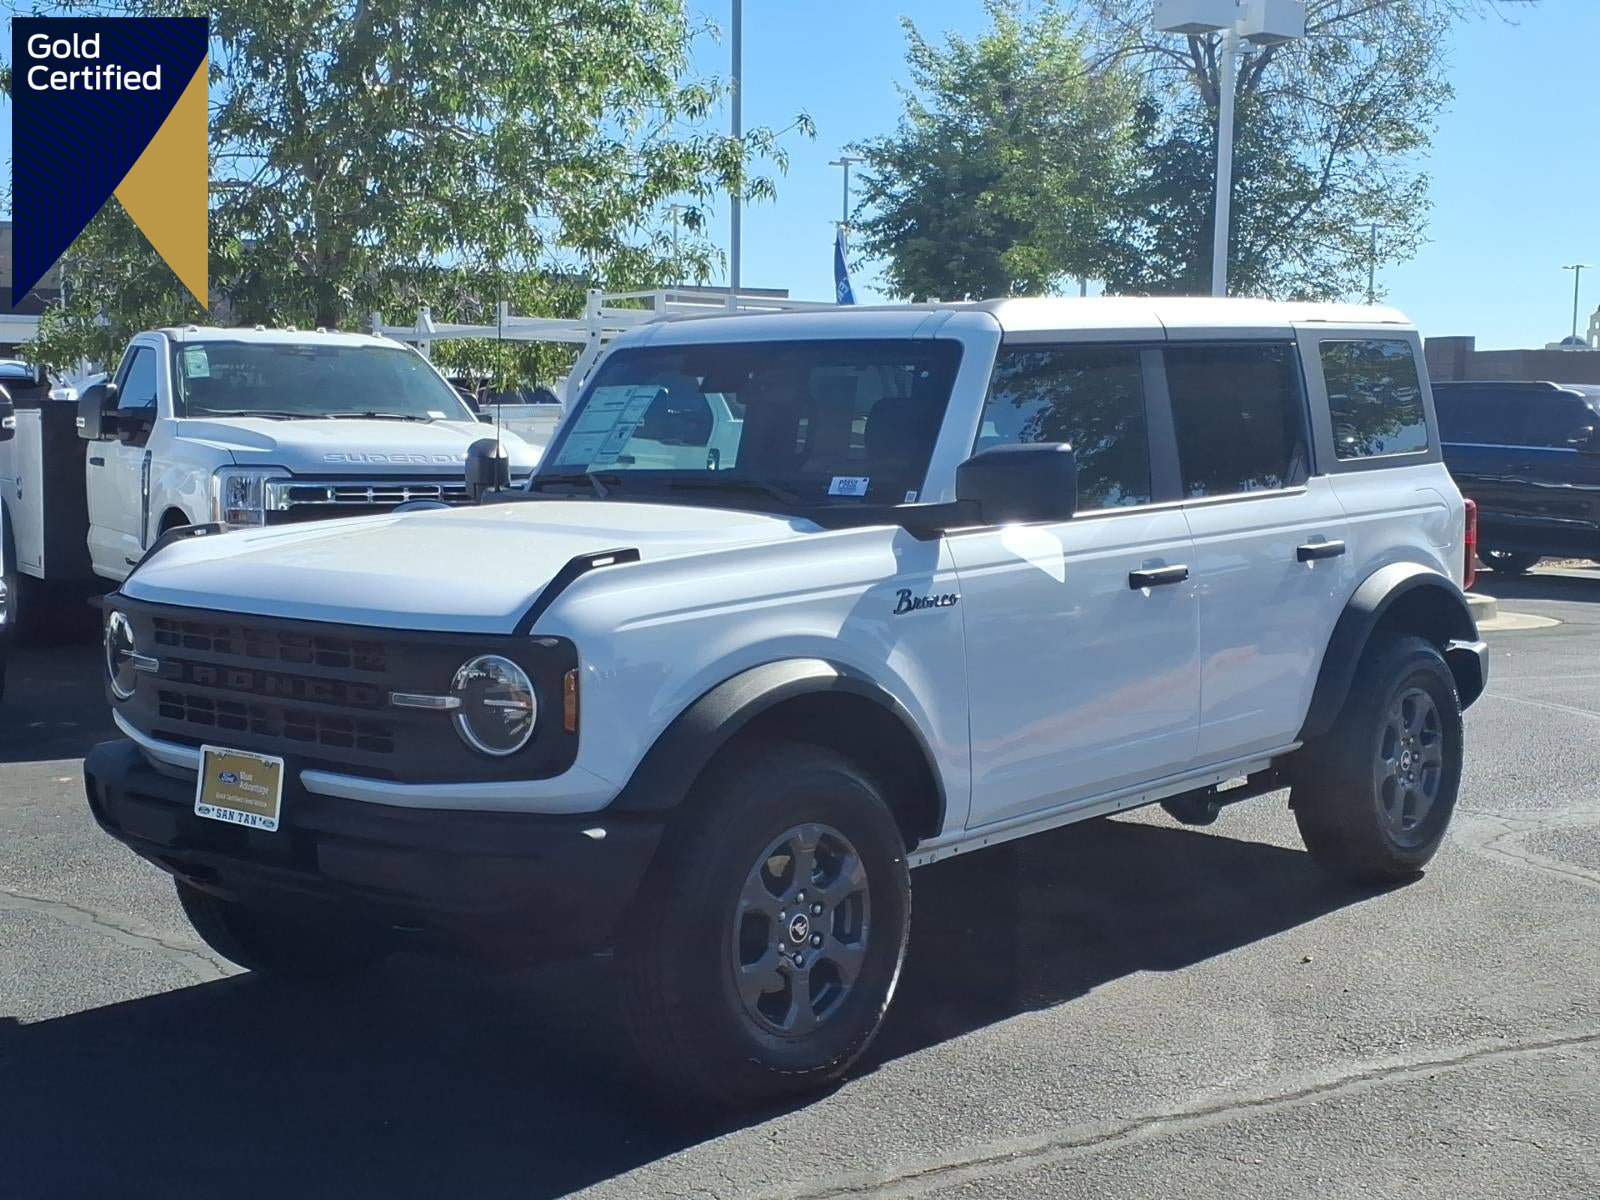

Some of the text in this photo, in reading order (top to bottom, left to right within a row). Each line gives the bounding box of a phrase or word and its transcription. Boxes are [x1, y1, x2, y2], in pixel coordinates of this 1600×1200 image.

[323, 453, 427, 464] SUPER
[893, 588, 959, 615] Bronco
[216, 808, 235, 821] SAN
[238, 813, 257, 826] TAN
